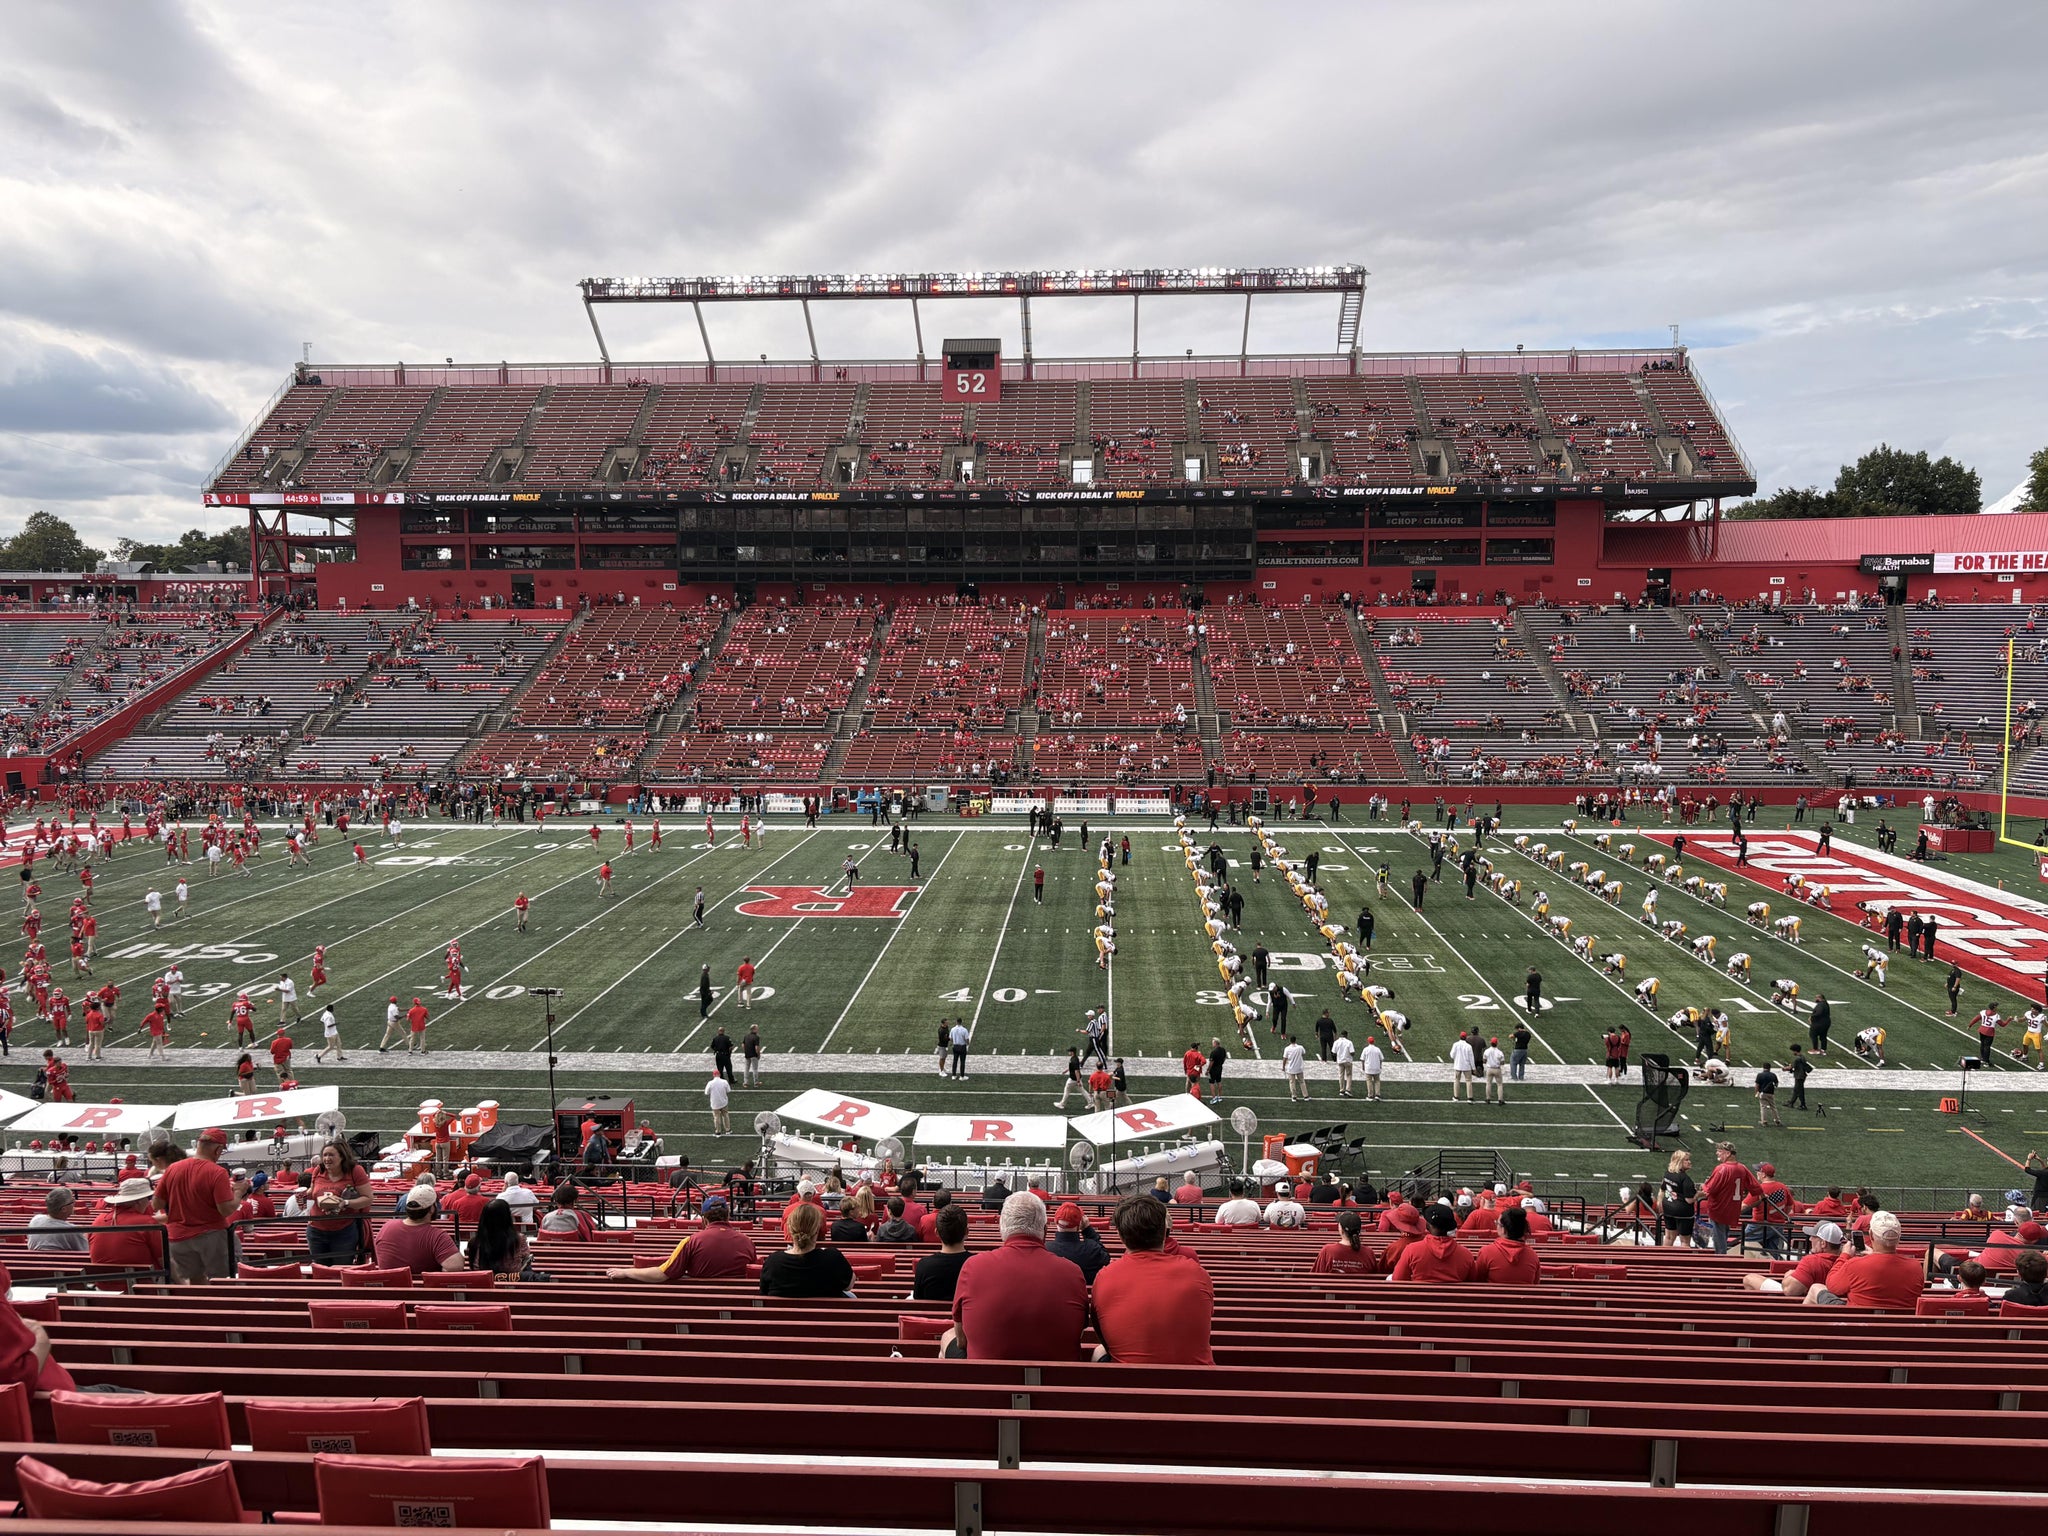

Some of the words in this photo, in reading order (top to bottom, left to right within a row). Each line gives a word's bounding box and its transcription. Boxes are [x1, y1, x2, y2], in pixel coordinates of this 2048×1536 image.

[957, 373, 986, 393] 52
[203, 494, 214, 503] R
[1954, 556, 1985, 570] FOR
[1989, 555, 2018, 569] THE
[734, 885, 923, 918] R
[939, 988, 1028, 1002] 40
[1457, 994, 1554, 1010] 20
[53, 1004, 64, 1012] 44
[234, 1006, 246, 1015] 26
[1982, 1015, 1994, 1026] 15
[232, 1096, 285, 1120] R
[1945, 1100, 1955, 1112] 10
[64, 1108, 123, 1128] R
[422, 1116, 430, 1124] G
[465, 1116, 472, 1125] G
[817, 1100, 870, 1128] R
[1115, 1108, 1174, 1133] R
[967, 1120, 1015, 1141] R
[1302, 1160, 1314, 1174] G
[1733, 1178, 1741, 1201] 1
